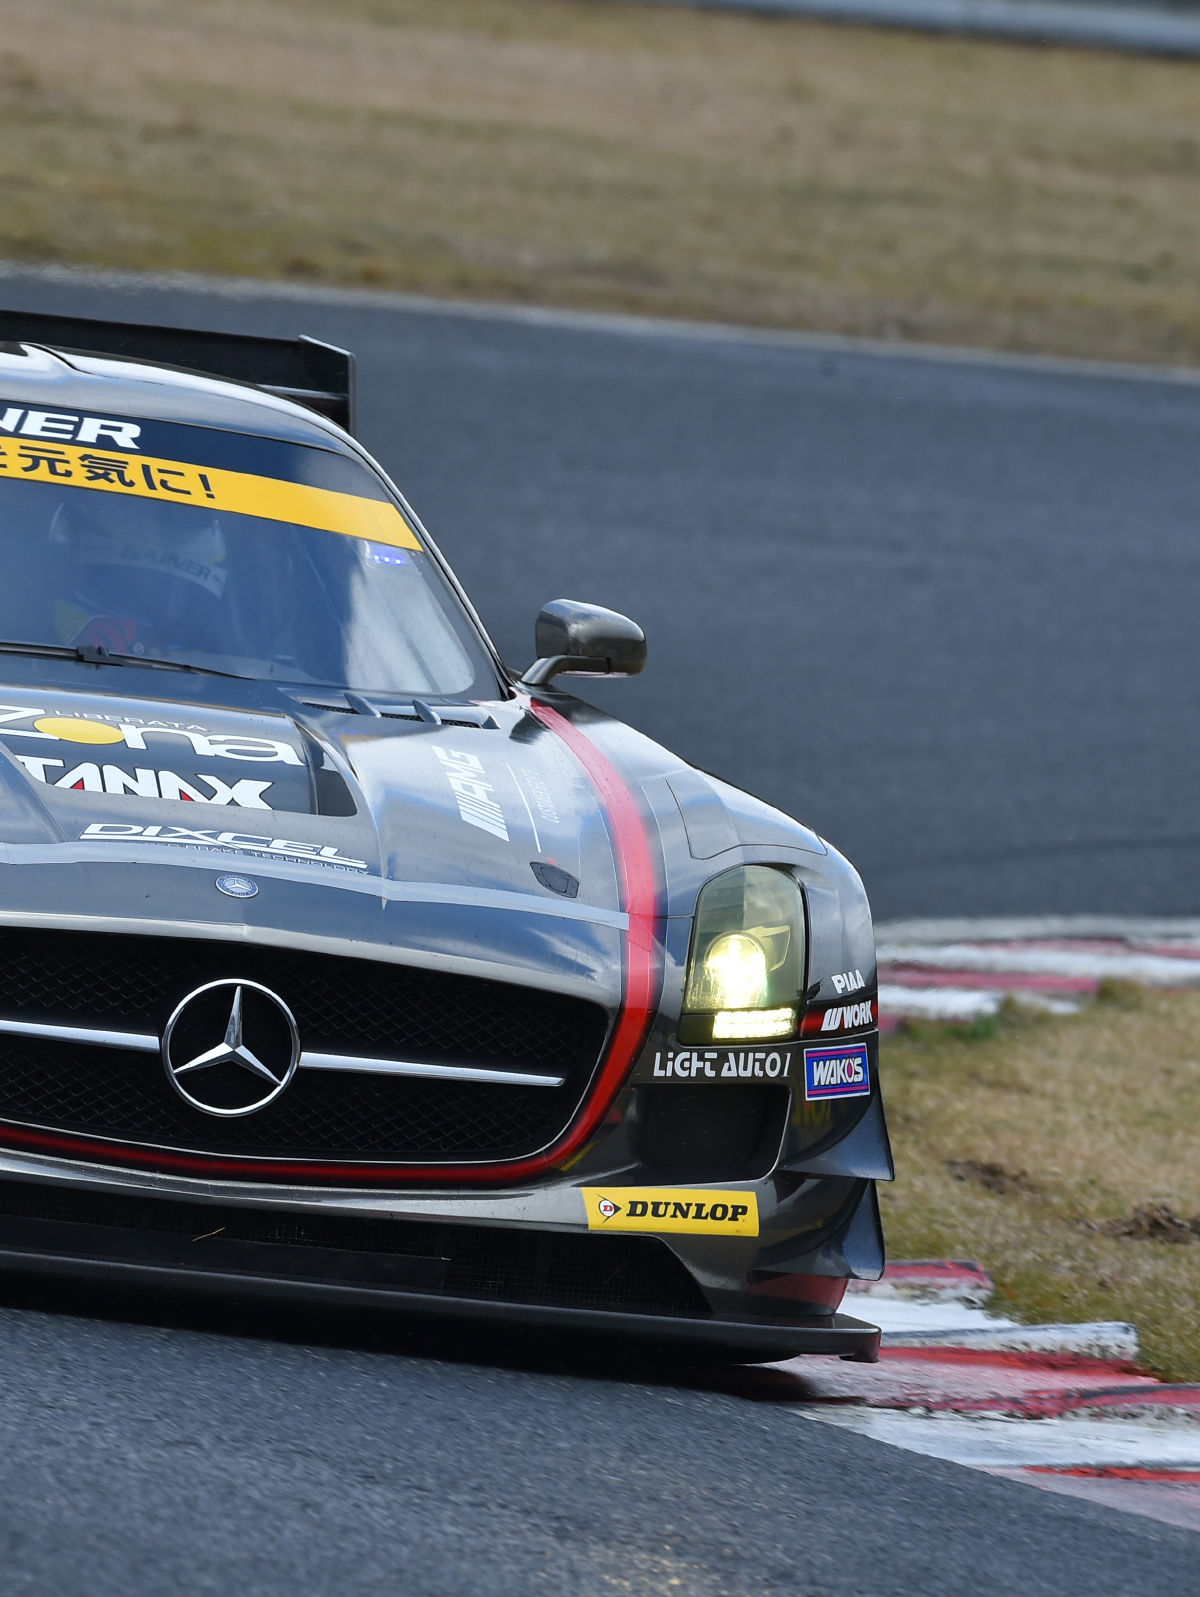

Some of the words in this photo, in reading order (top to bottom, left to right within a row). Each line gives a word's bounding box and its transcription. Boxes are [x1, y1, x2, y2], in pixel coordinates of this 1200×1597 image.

[120, 547, 212, 581] GAINER
[54, 710, 211, 732] LIBERATA
[15, 754, 275, 811] TANAX
[81, 823, 368, 867] DIXCEL
[831, 969, 866, 994] PIAA
[841, 999, 874, 1029] WORK
[626, 1200, 749, 1222] DUNLOP
